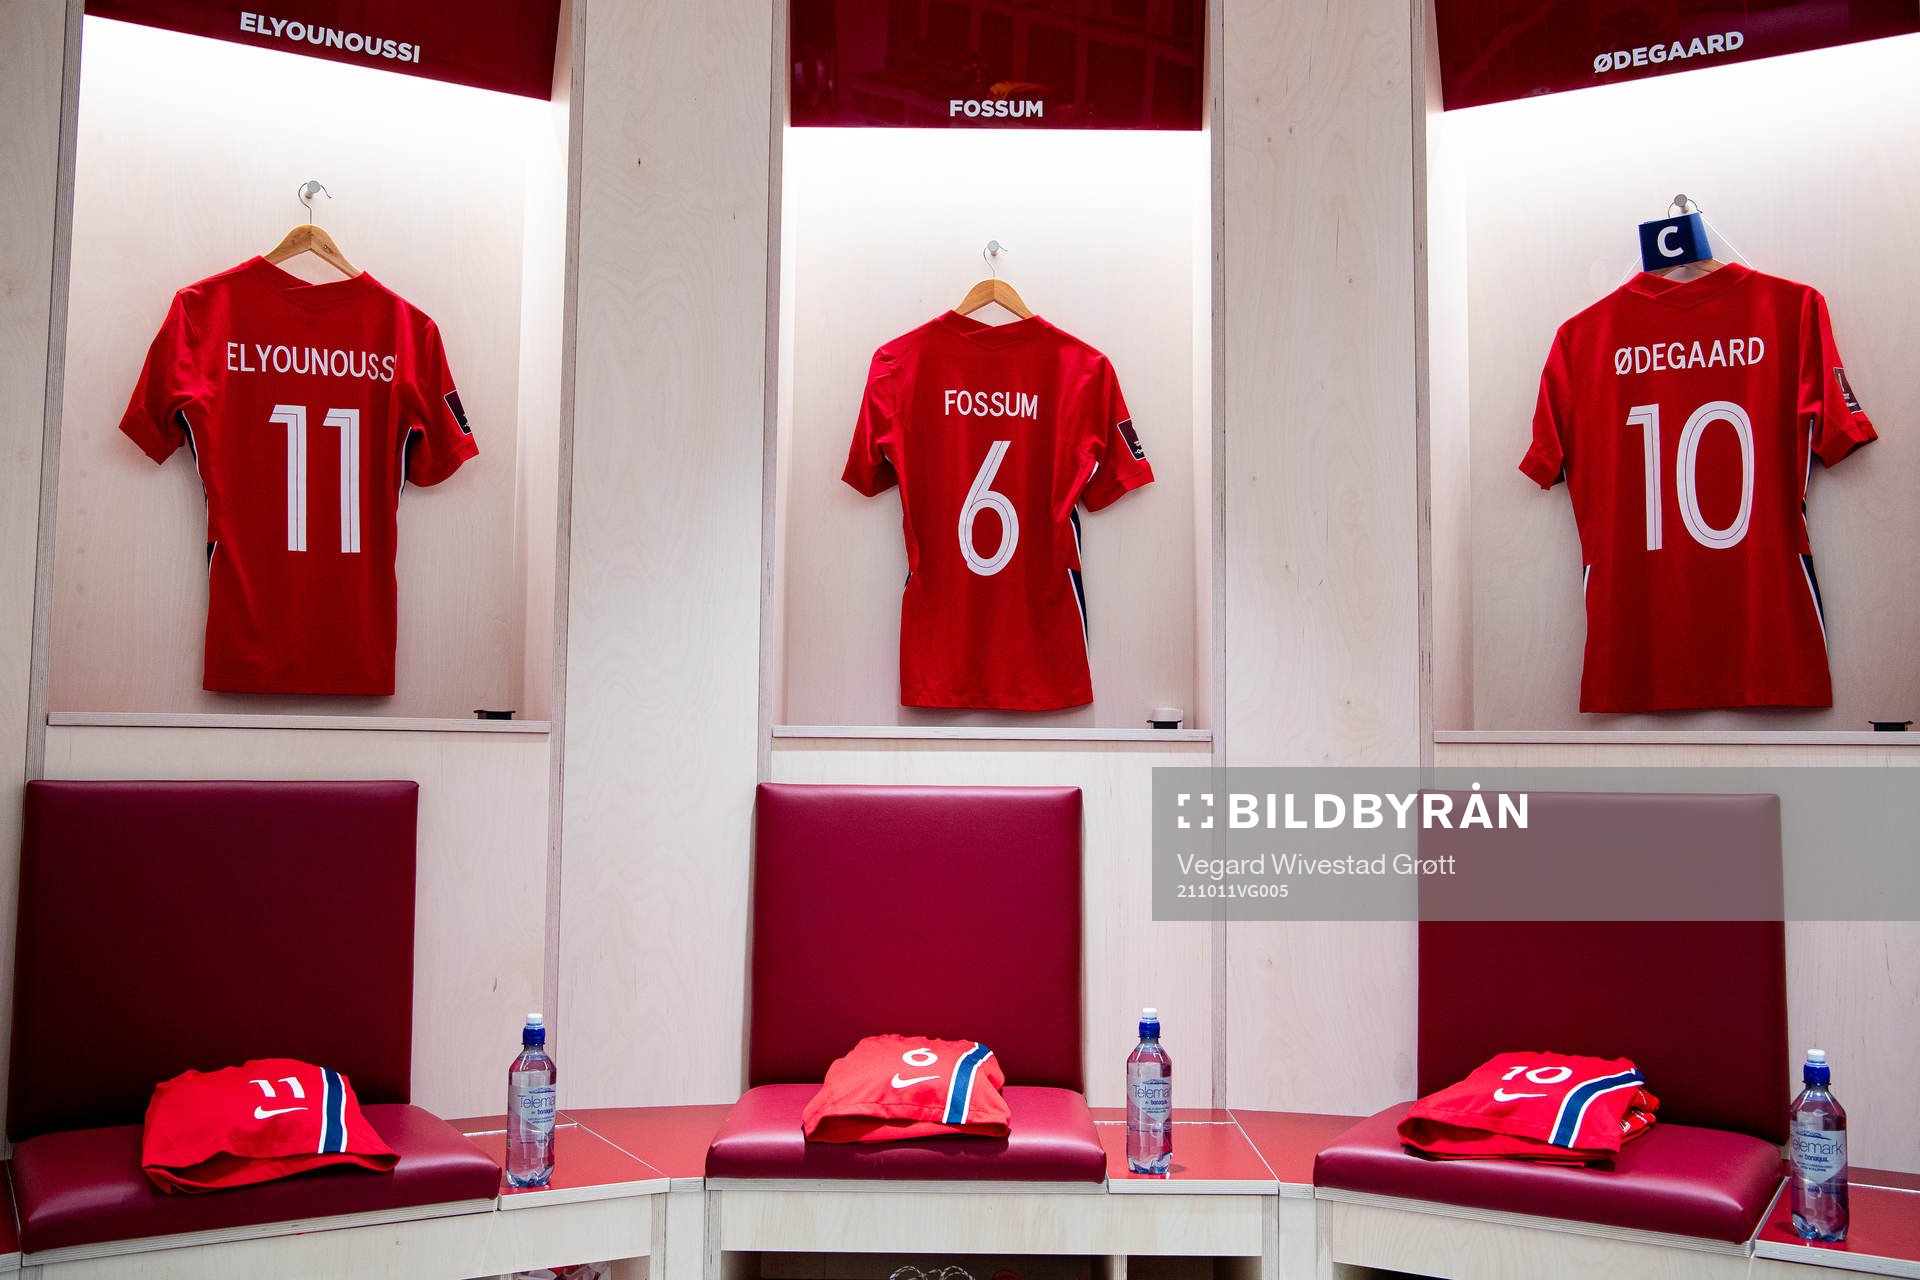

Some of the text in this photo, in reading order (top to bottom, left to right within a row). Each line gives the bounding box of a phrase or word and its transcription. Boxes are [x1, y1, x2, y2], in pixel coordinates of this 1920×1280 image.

[239, 12, 421, 63] ELYOUNOUSSI
[1593, 31, 1744, 74] ØDEGAARD
[949, 100, 1044, 118] FOSSUM
[1657, 226, 1684, 258] C
[1614, 337, 1765, 375] ØDEGAARD
[944, 390, 1038, 420] FOSSUM
[269, 405, 360, 553] 11
[1626, 401, 1754, 550] 10
[958, 441, 1019, 576] 6
[902, 1048, 937, 1067] 6
[249, 1077, 305, 1099] 11
[1502, 1066, 1572, 1084] 10
[517, 1095, 555, 1108] Telema
[1132, 1084, 1170, 1098] Telema
[1791, 1136, 1843, 1155] elemark
